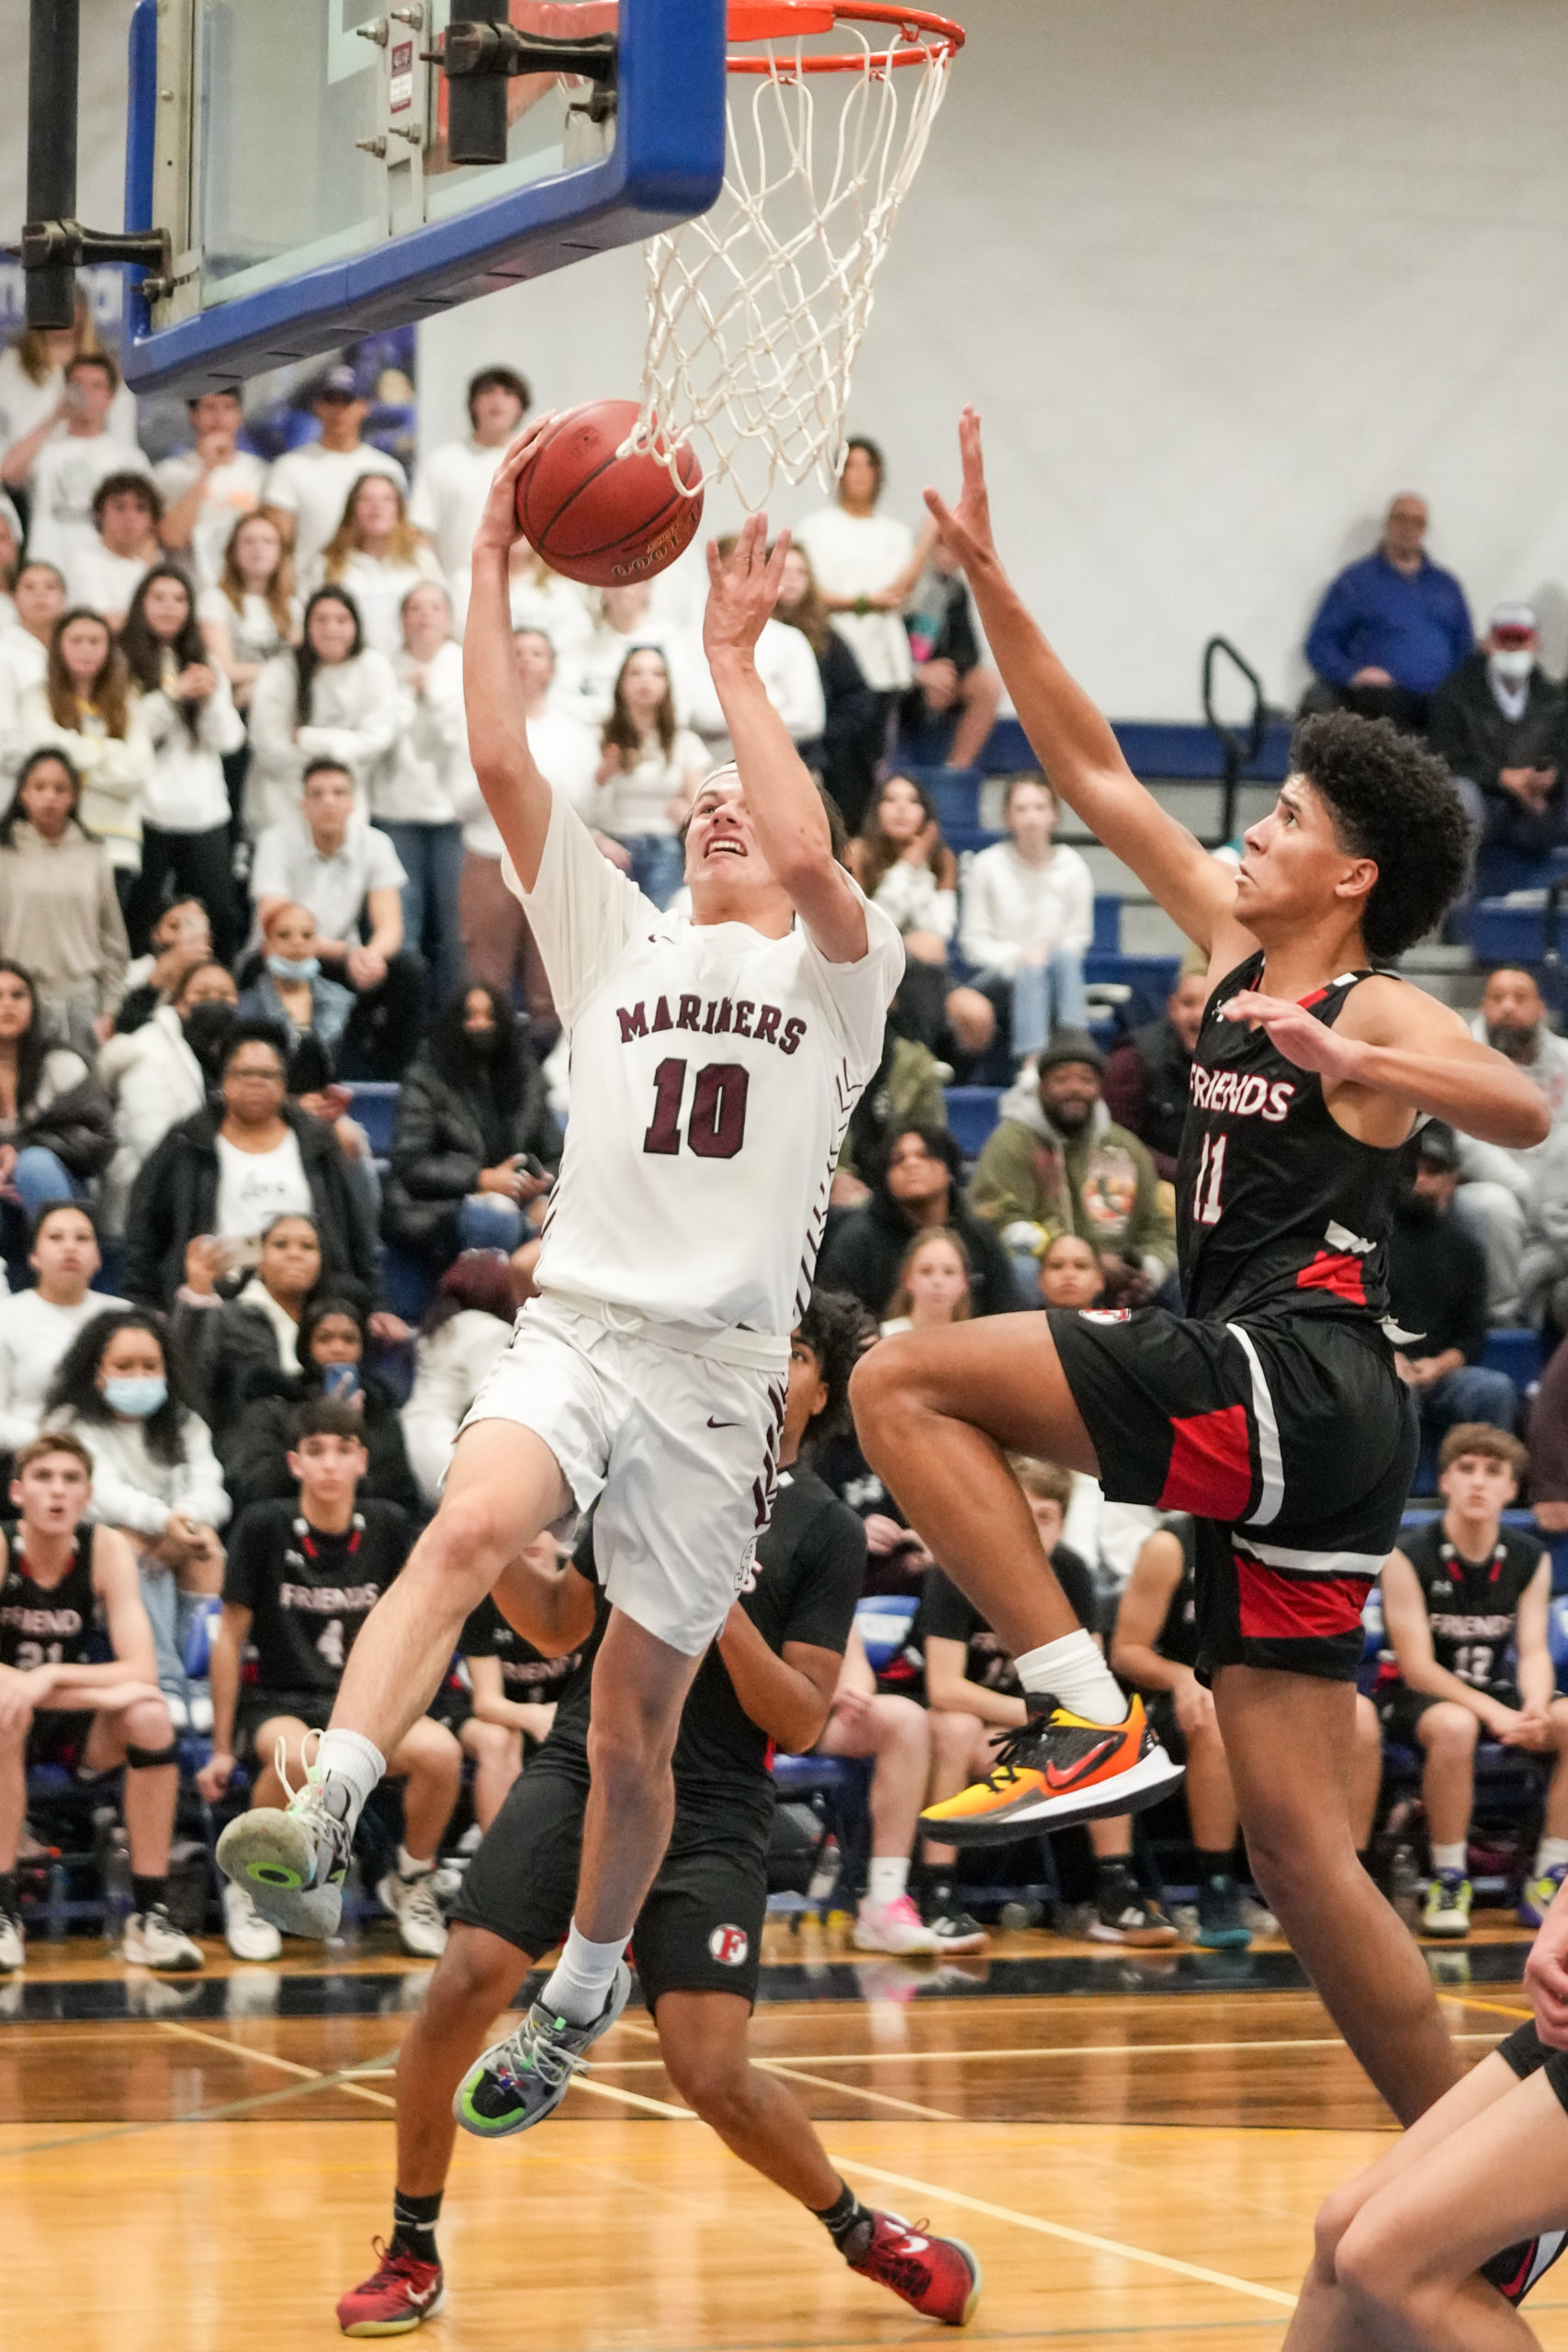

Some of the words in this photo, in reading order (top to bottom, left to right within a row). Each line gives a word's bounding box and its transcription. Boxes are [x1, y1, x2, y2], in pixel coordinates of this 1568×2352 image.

[616, 993, 807, 1056] MARINERS
[643, 1057, 750, 1159] 10
[1193, 1131, 1227, 1227] 11
[316, 1619, 345, 1668] 4
[716, 1928, 747, 1962] F
